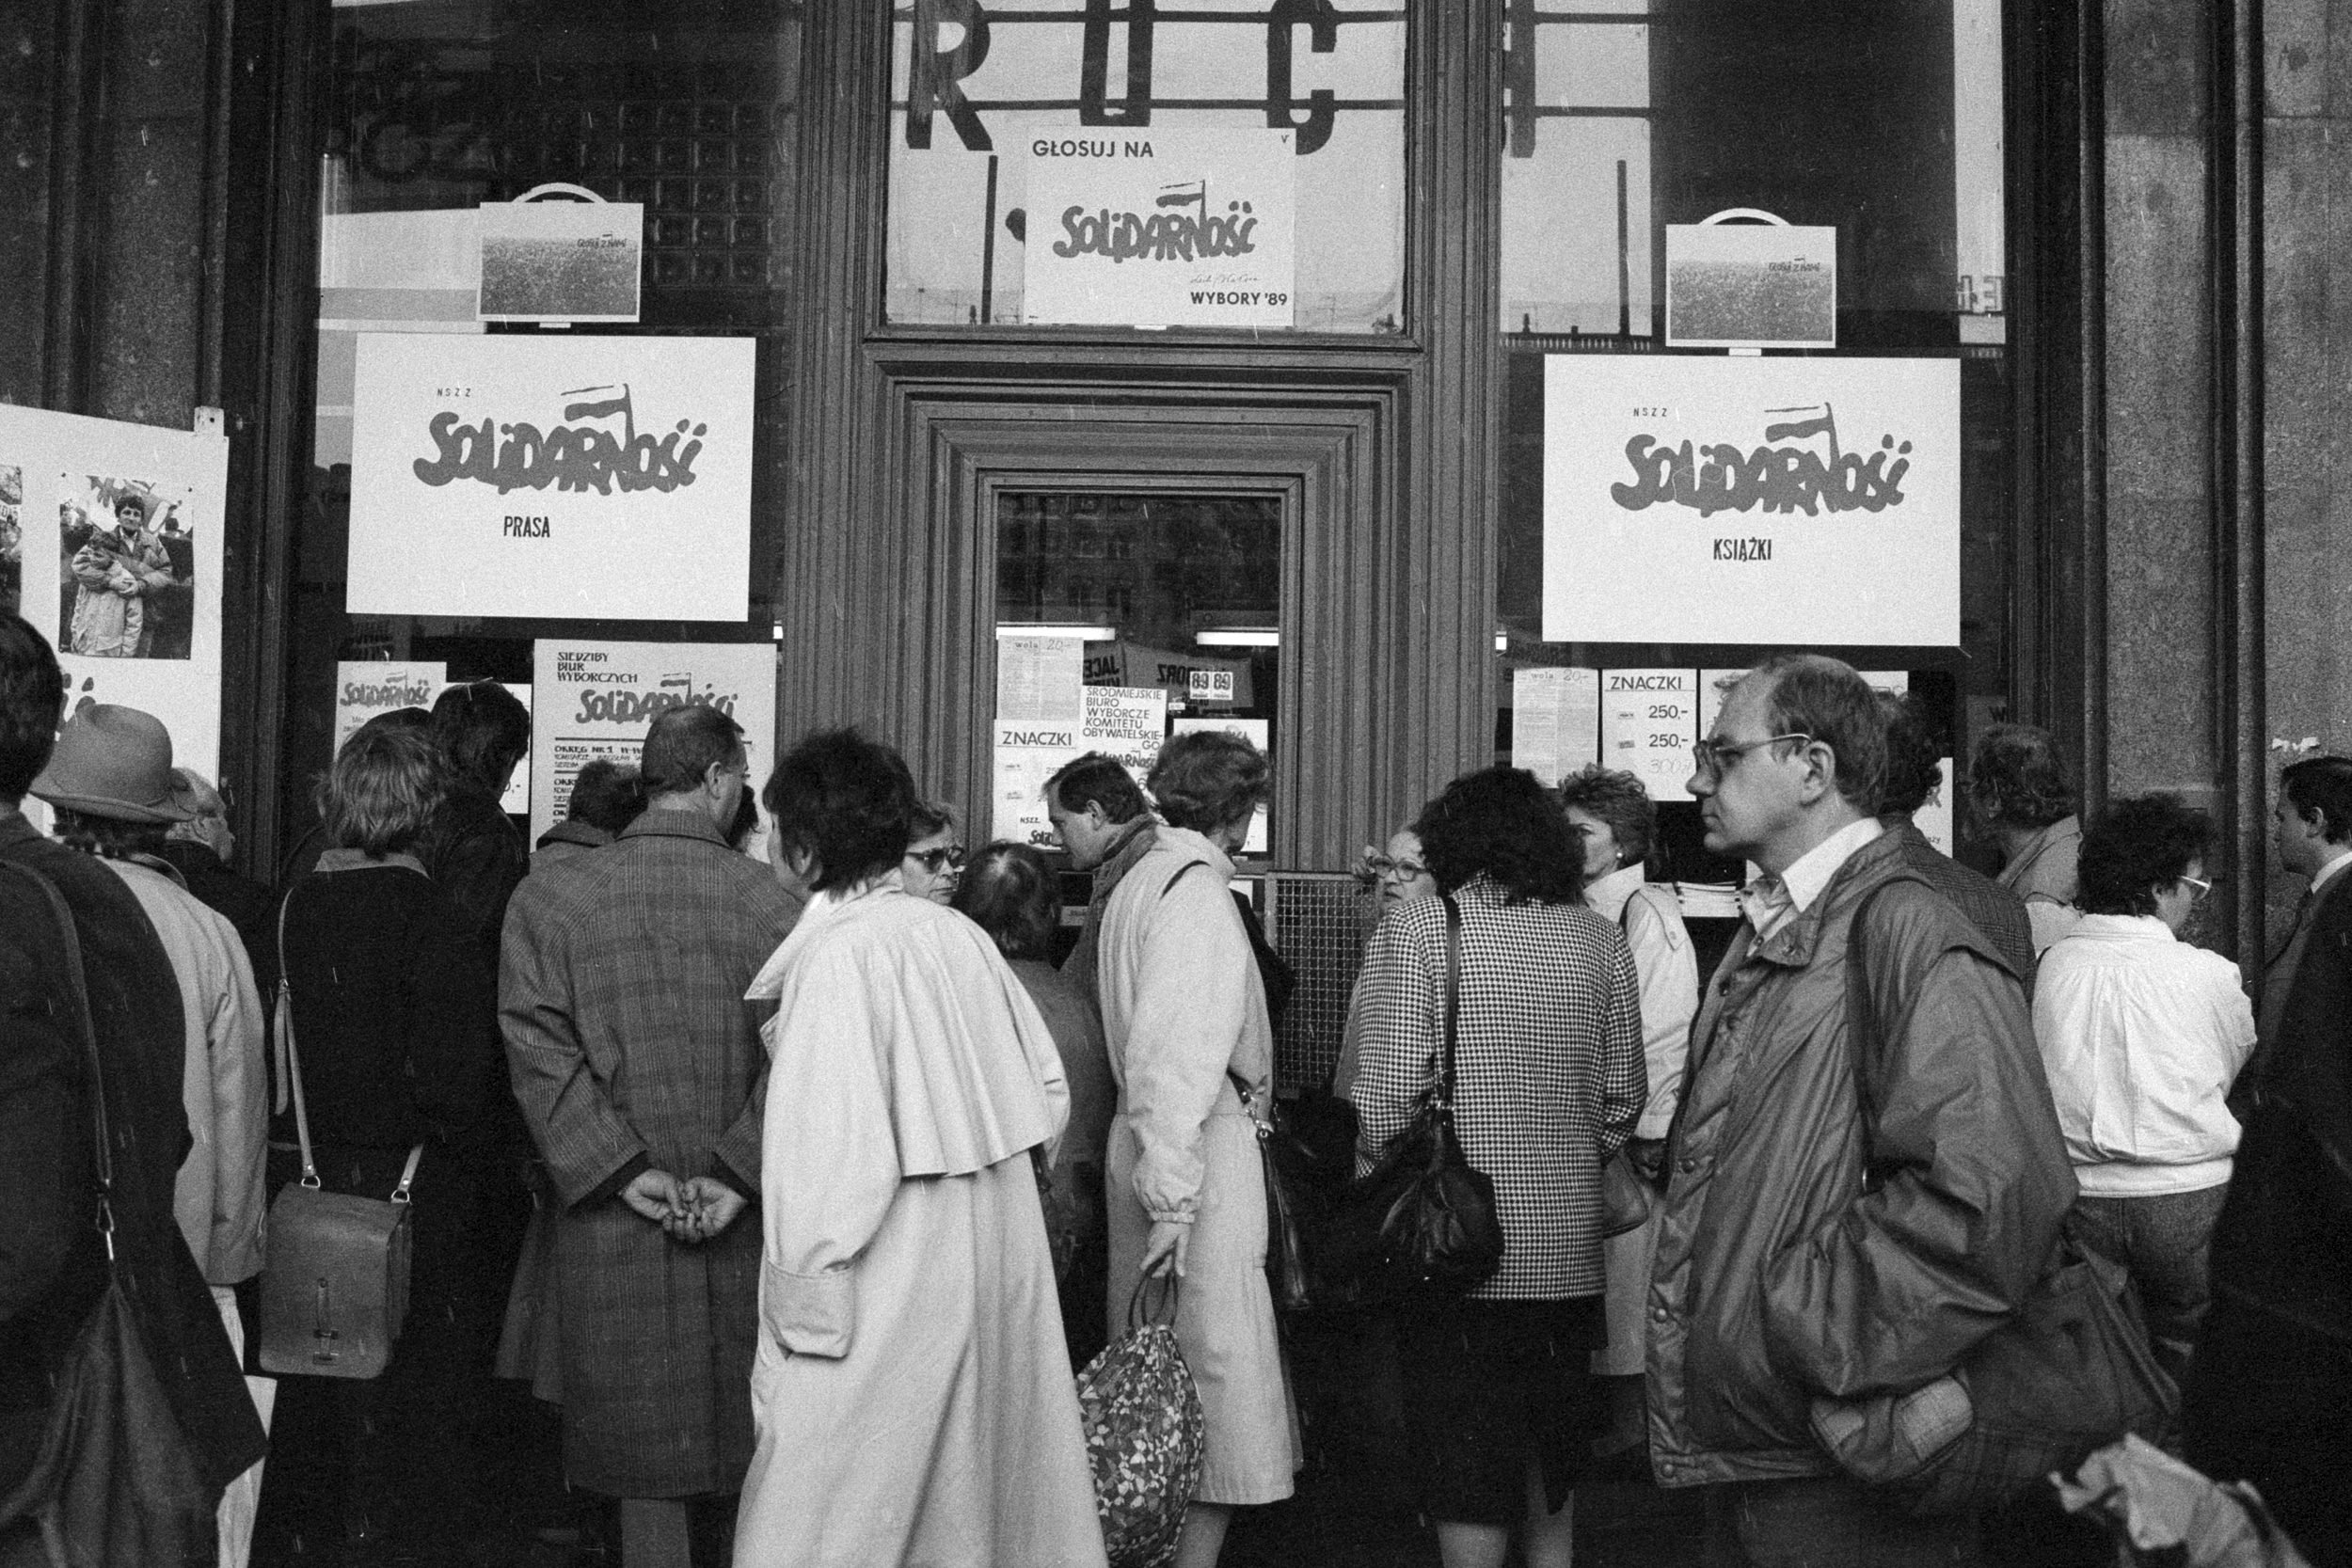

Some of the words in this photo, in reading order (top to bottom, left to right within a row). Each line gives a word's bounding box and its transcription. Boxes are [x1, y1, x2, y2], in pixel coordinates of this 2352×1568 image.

[1033, 140, 1115, 157] GŁOSUJ
[1125, 142, 1153, 157] NA
[1190, 292, 1261, 305] WYBORY
[1264, 293, 1288, 306] '89
[503, 515, 550, 537] PRASA
[1713, 537, 1772, 562] KSIĄŻKI
[557, 652, 609, 662] SIEDZIBY
[557, 662, 585, 672] BIUR
[557, 672, 638, 683] WYBORCZYCH
[1610, 676, 1682, 690] ZNACZKI
[1086, 697, 1120, 707] BIURO
[1087, 707, 1150, 720] WYBORCZE
[1086, 718, 1143, 729] KOMITETU
[1002, 731, 1072, 746] ZNACZKI
[1141, 740, 1160, 750] GO
